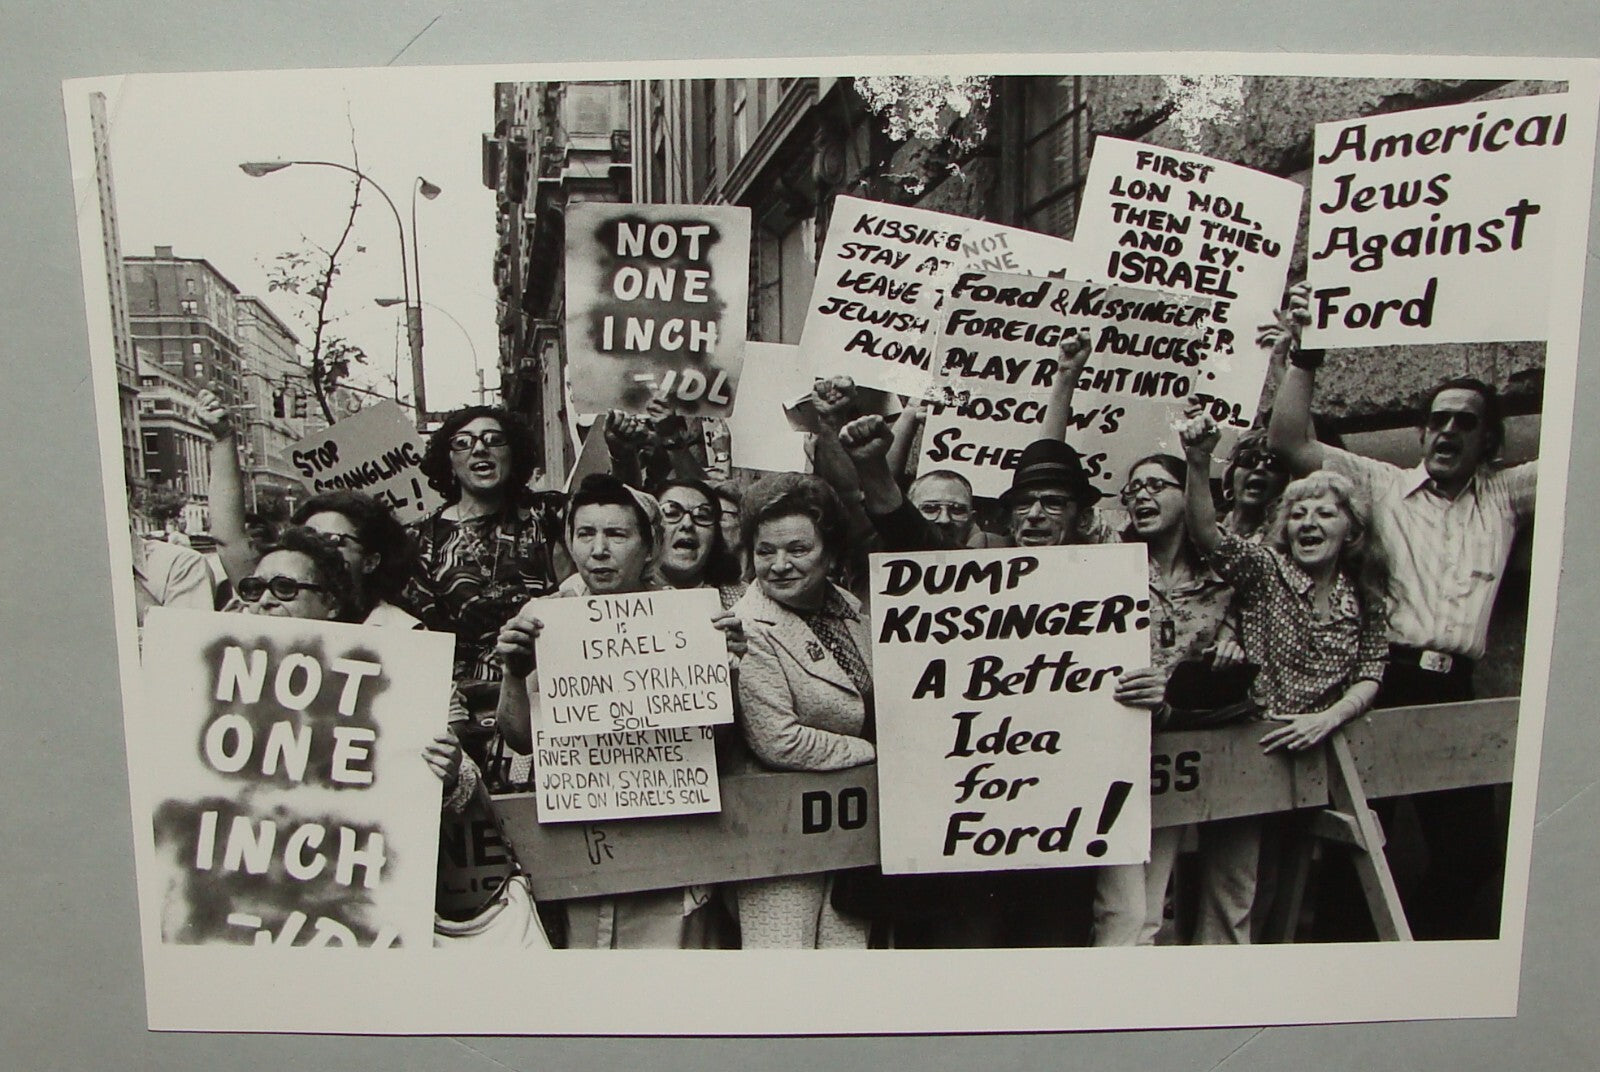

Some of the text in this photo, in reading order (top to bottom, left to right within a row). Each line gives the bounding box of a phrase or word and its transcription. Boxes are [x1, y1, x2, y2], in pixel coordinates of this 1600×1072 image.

[1136, 150, 1214, 184] FIRST
[1109, 175, 1171, 203] LON
[1319, 173, 1452, 214] Jews
[617, 222, 710, 260] NOT
[962, 232, 1008, 258] NOT
[1111, 202, 1281, 258] THEN THIEU
[1119, 229, 1183, 257] AND
[1312, 199, 1541, 272] Against
[837, 242, 911, 269] STAY
[613, 267, 710, 303] ONE
[837, 269, 922, 304] LEAVE
[1107, 250, 1238, 299] ISRAEL
[1050, 288, 1068, 316] &
[1314, 277, 1438, 329] Ford
[603, 315, 717, 352] INCH
[844, 329, 932, 370] ALON
[941, 347, 1190, 398] PLAY RGHT INTO
[293, 440, 339, 478] STOP
[878, 556, 1039, 597] DUMP
[587, 597, 654, 622] SINAI
[616, 622, 628, 634] IS
[879, 594, 1150, 645] KISSINGER:
[582, 630, 687, 660] ISRAEL'S
[216, 646, 381, 716] NOT
[688, 664, 729, 687] IRAQ
[912, 651, 1124, 702] A Better
[553, 691, 718, 724] LIVE ON ISRAEL'S
[613, 716, 659, 732] SOIL
[205, 714, 375, 784] ONE
[656, 727, 693, 744] NILE
[699, 725, 714, 741] TO
[944, 710, 1061, 759] Idea
[673, 767, 708, 788] IRAQ
[954, 762, 1040, 804] for
[546, 788, 711, 810] LIVE ON ISRAEL'S SOIL
[801, 786, 868, 835] DO
[196, 811, 386, 888] INCH
